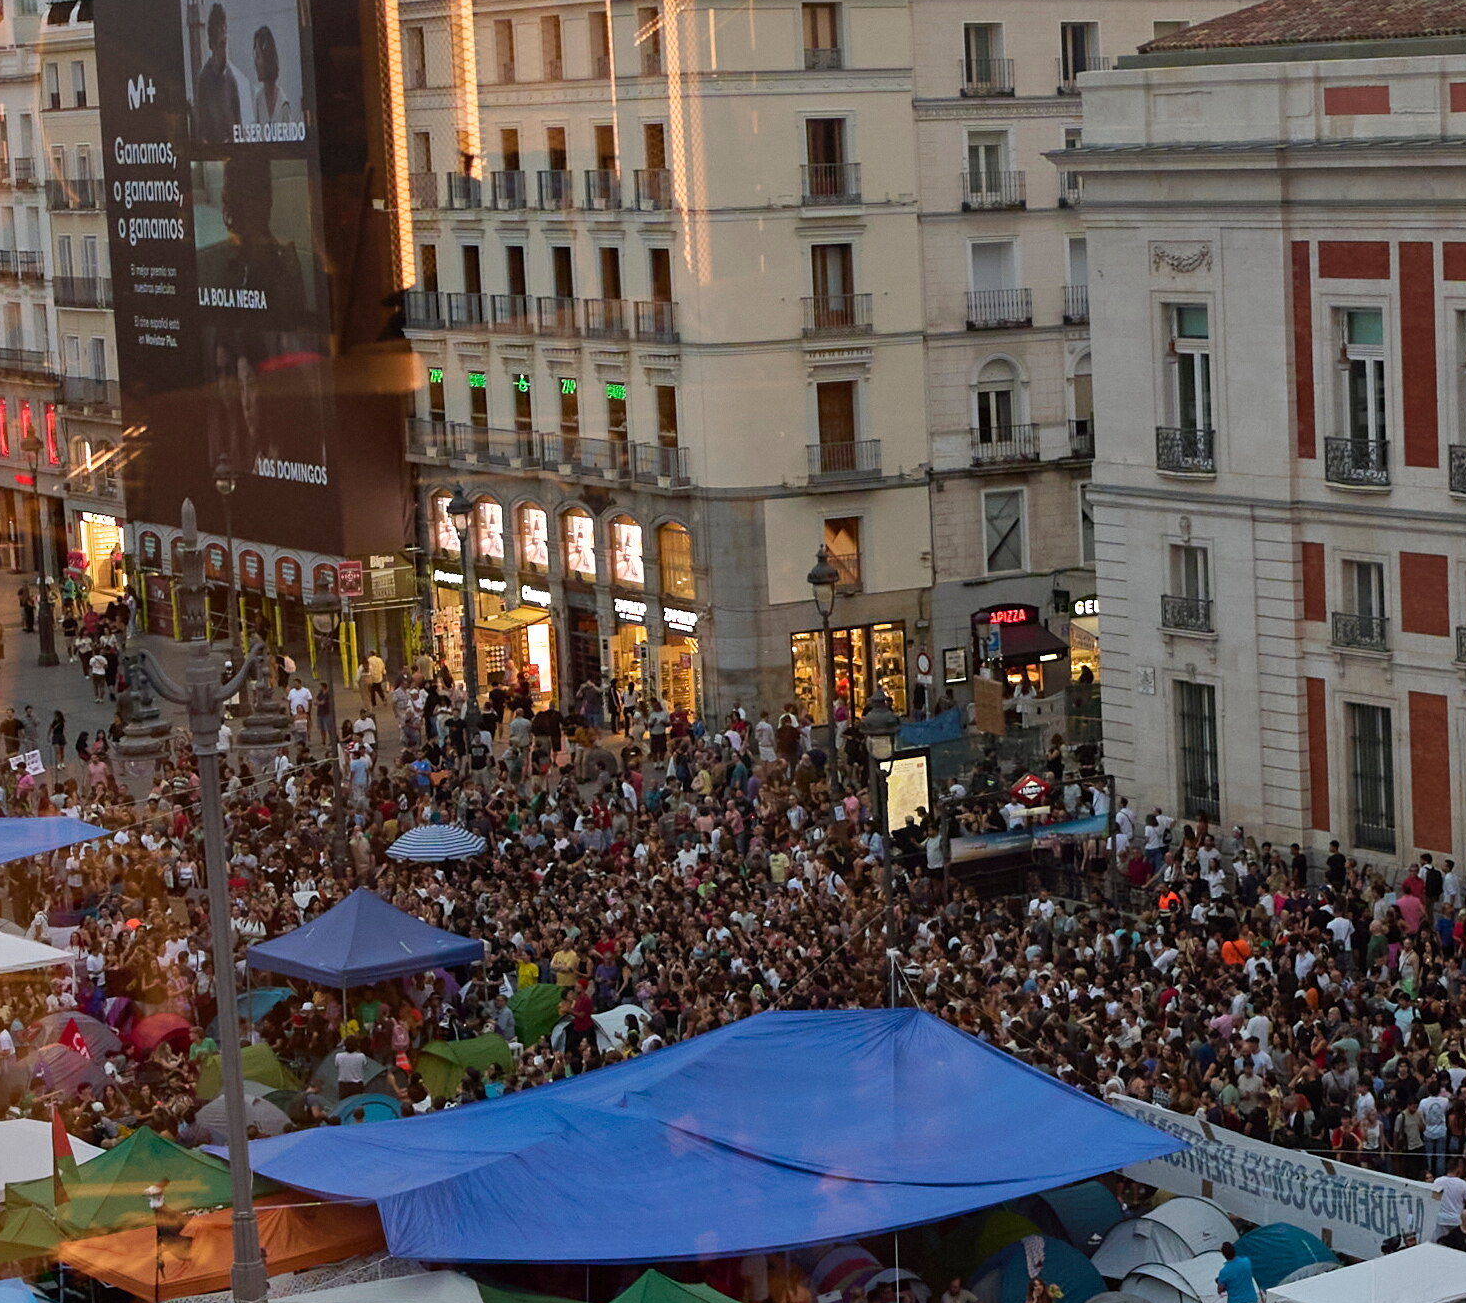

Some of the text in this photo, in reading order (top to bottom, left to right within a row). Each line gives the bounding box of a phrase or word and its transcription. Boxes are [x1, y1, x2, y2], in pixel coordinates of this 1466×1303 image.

[233, 122, 306, 143] EL SER QUERIDO
[115, 137, 177, 168] Ganamos,
[114, 179, 183, 209] o ganamos,
[118, 217, 184, 246] o ganamos
[199, 287, 267, 309] LA BOLA NEGRA
[258, 457, 328, 485] LOS DOMINGOS
